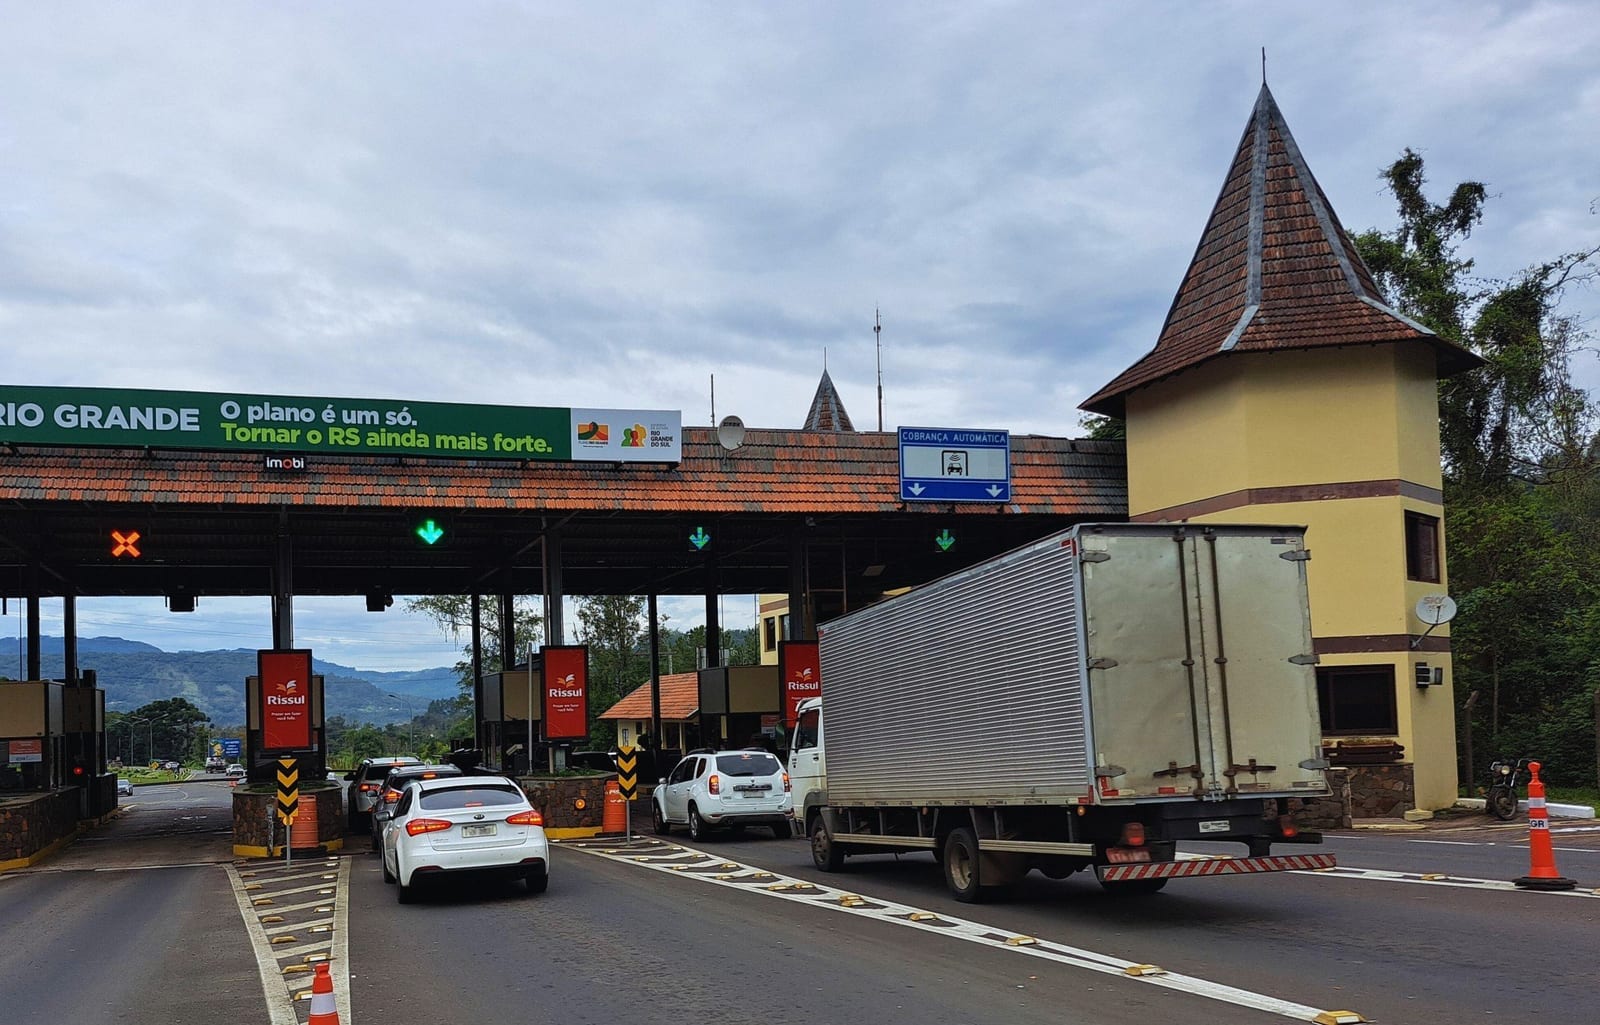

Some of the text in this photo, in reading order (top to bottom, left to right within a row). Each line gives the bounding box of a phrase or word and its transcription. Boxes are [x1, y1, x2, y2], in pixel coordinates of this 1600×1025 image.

[53, 404, 201, 432] GRANDE
[220, 400, 418, 426] O plano é um só.
[220, 422, 553, 453] Tornar o RS ainda mais forte.
[902, 431, 1006, 444] COBRANÇA AUTOMÁTICA
[266, 457, 305, 469] imobi
[788, 681, 819, 690] Rissul
[549, 687, 583, 697] Rissul
[267, 694, 305, 705] Rissul
[1529, 820, 1545, 828] GR
